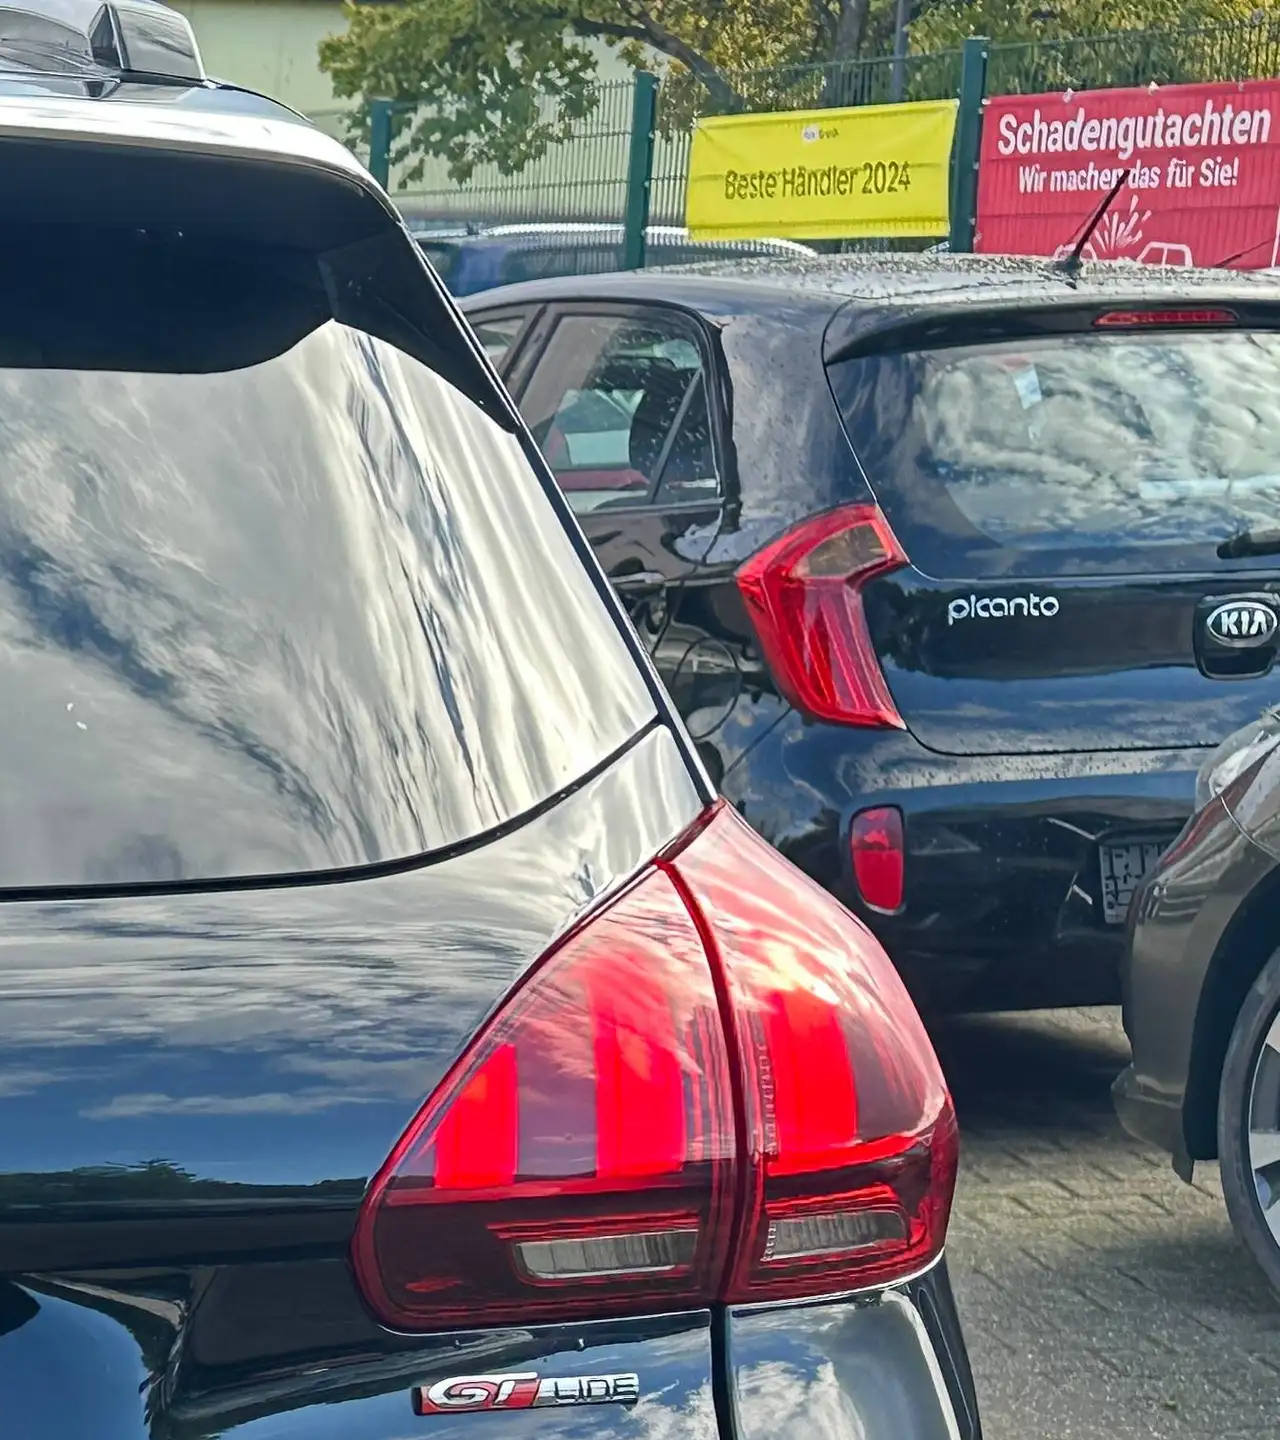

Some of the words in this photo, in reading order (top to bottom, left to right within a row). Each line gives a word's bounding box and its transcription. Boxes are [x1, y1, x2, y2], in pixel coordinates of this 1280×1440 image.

[997, 98, 1272, 160] Schadengutachten
[724, 169, 778, 200] Beste
[781, 164, 858, 198] Händler
[861, 160, 912, 194] 2024
[1018, 163, 1047, 193] Wir
[1127, 159, 1161, 189] das
[1166, 157, 1195, 188] für
[1199, 155, 1239, 188] Sie!
[947, 592, 1060, 626] picanto
[1220, 609, 1268, 636] KIA
[428, 1371, 539, 1408] GT
